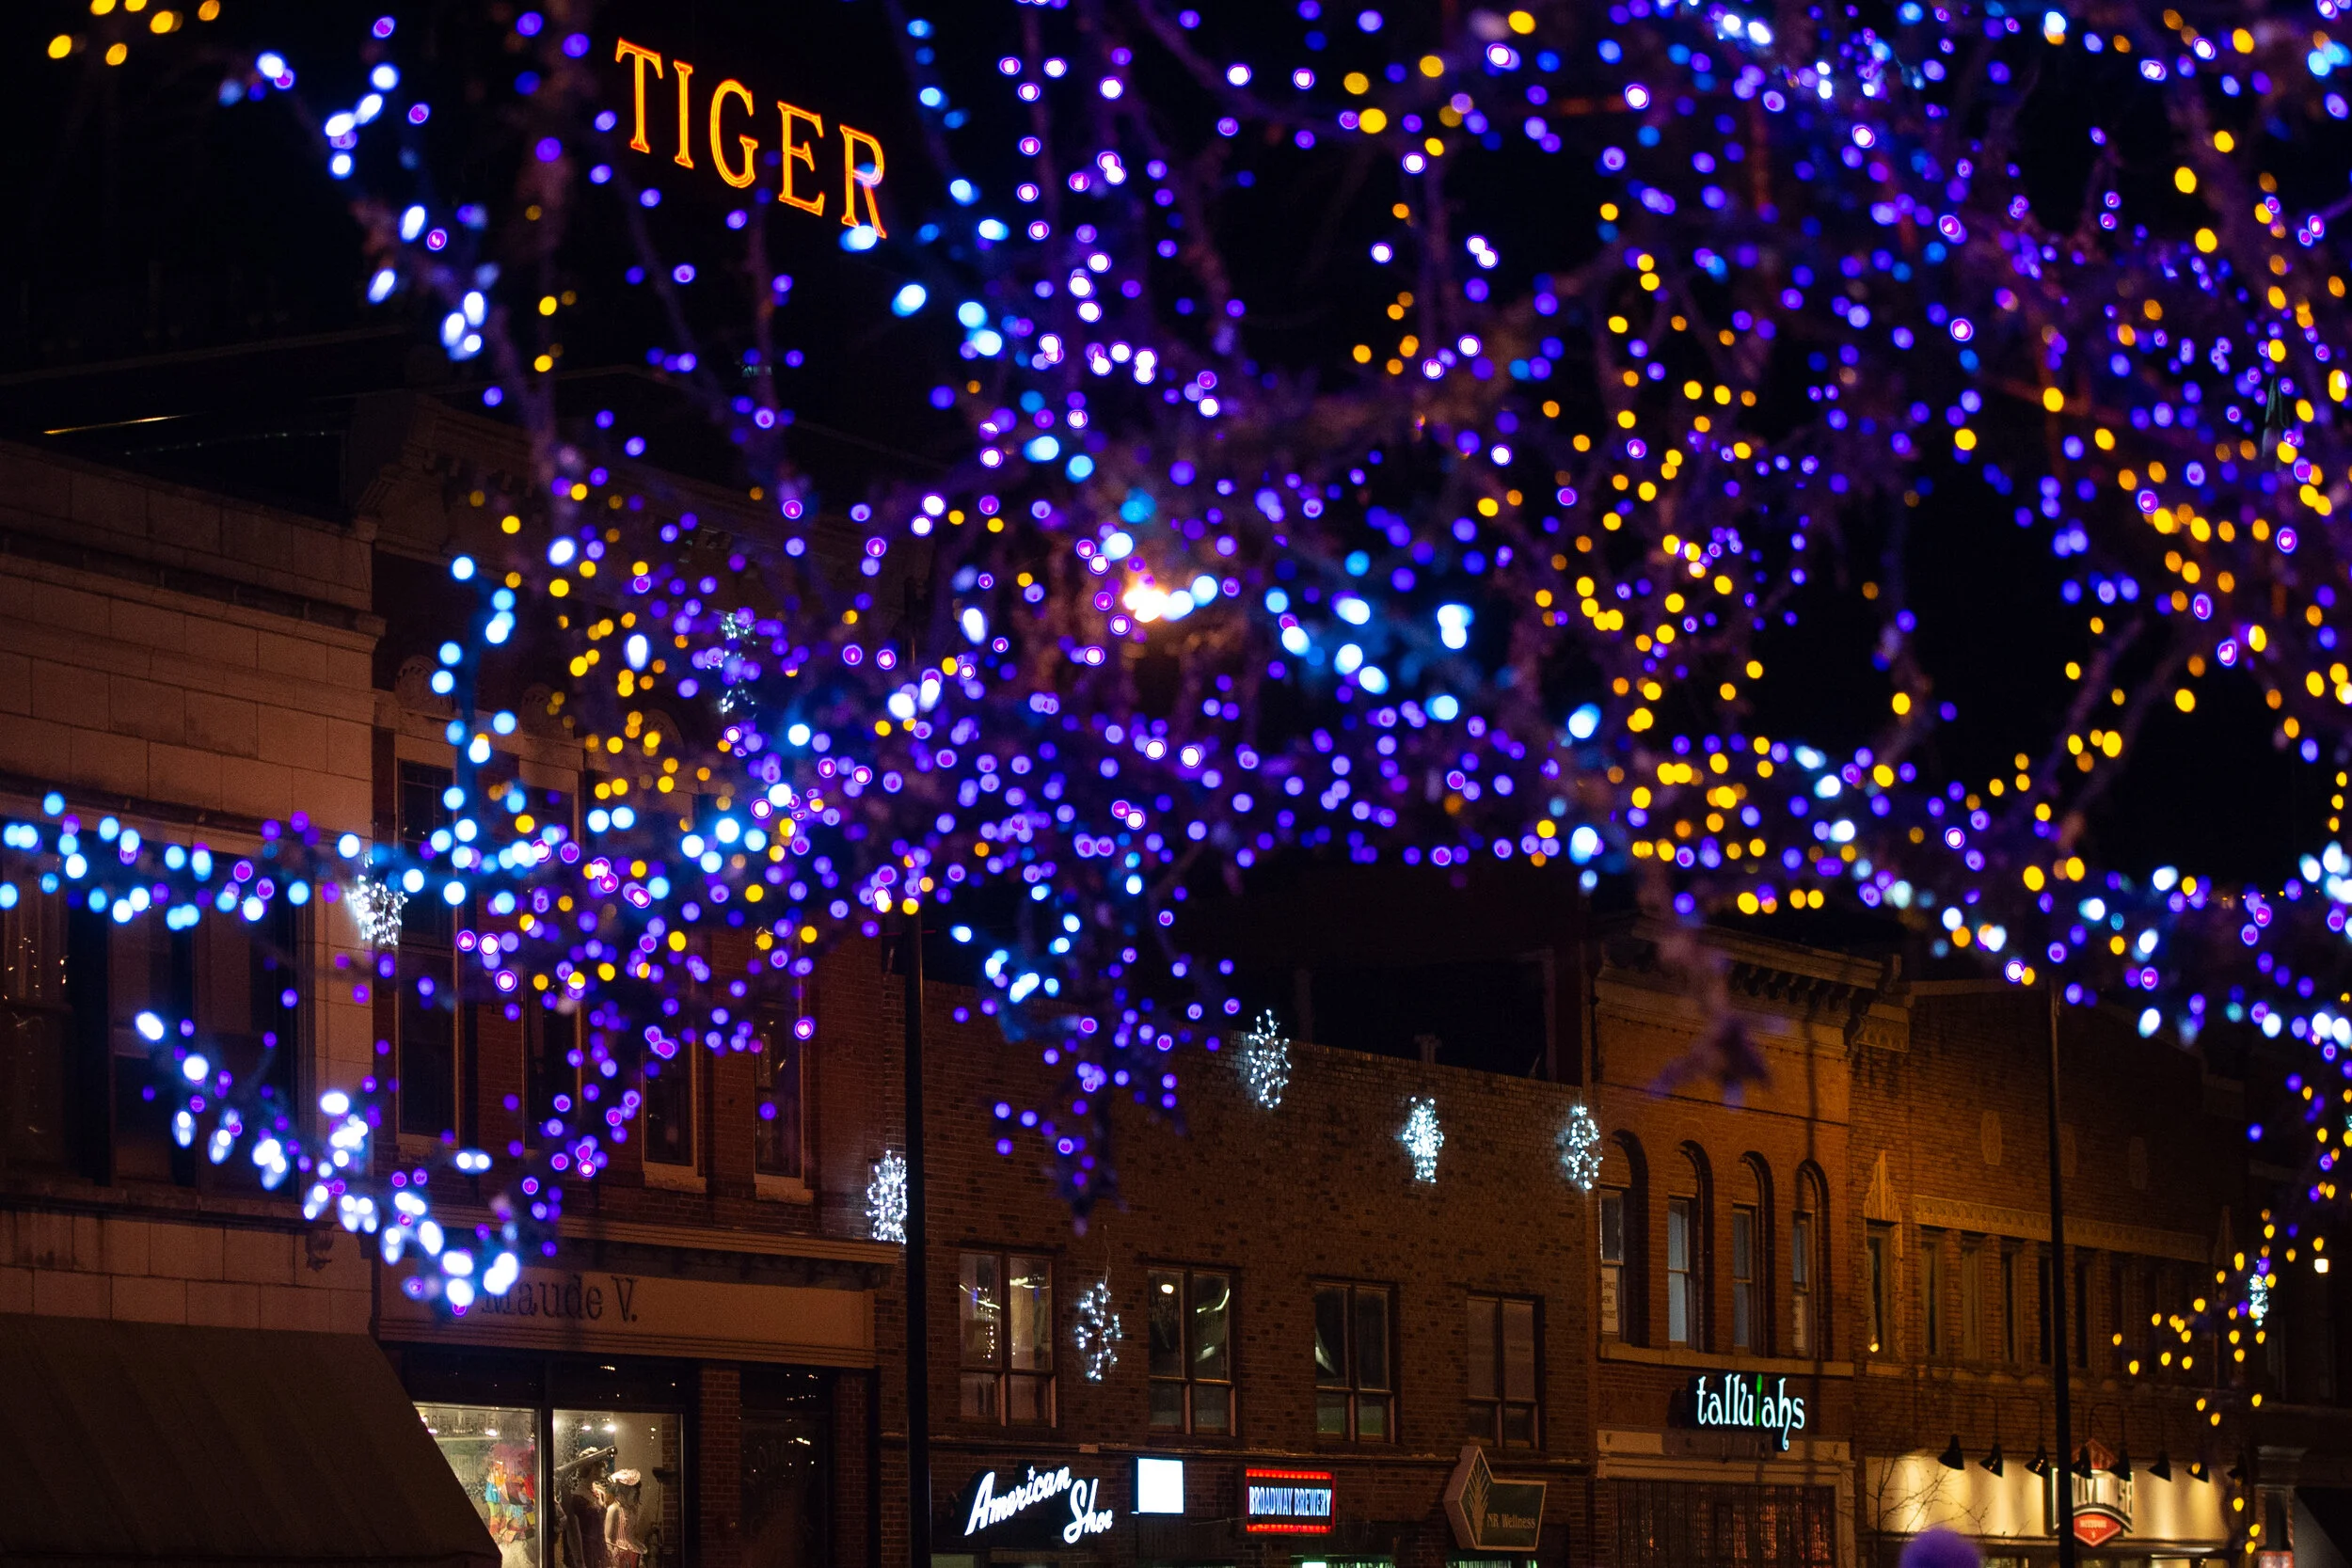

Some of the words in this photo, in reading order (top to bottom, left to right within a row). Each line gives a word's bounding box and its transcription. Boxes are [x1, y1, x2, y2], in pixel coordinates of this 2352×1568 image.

[615, 38, 887, 239] TIGER
[611, 1275, 639, 1323] V.
[1696, 1373, 1805, 1450] tallulahs
[963, 1465, 1073, 1536] American
[1063, 1478, 1113, 1544] Shoe
[1248, 1486, 1294, 1515] BROADWAY
[1294, 1488, 1332, 1516] BREWERY
[1502, 1513, 1536, 1529] Wellness
